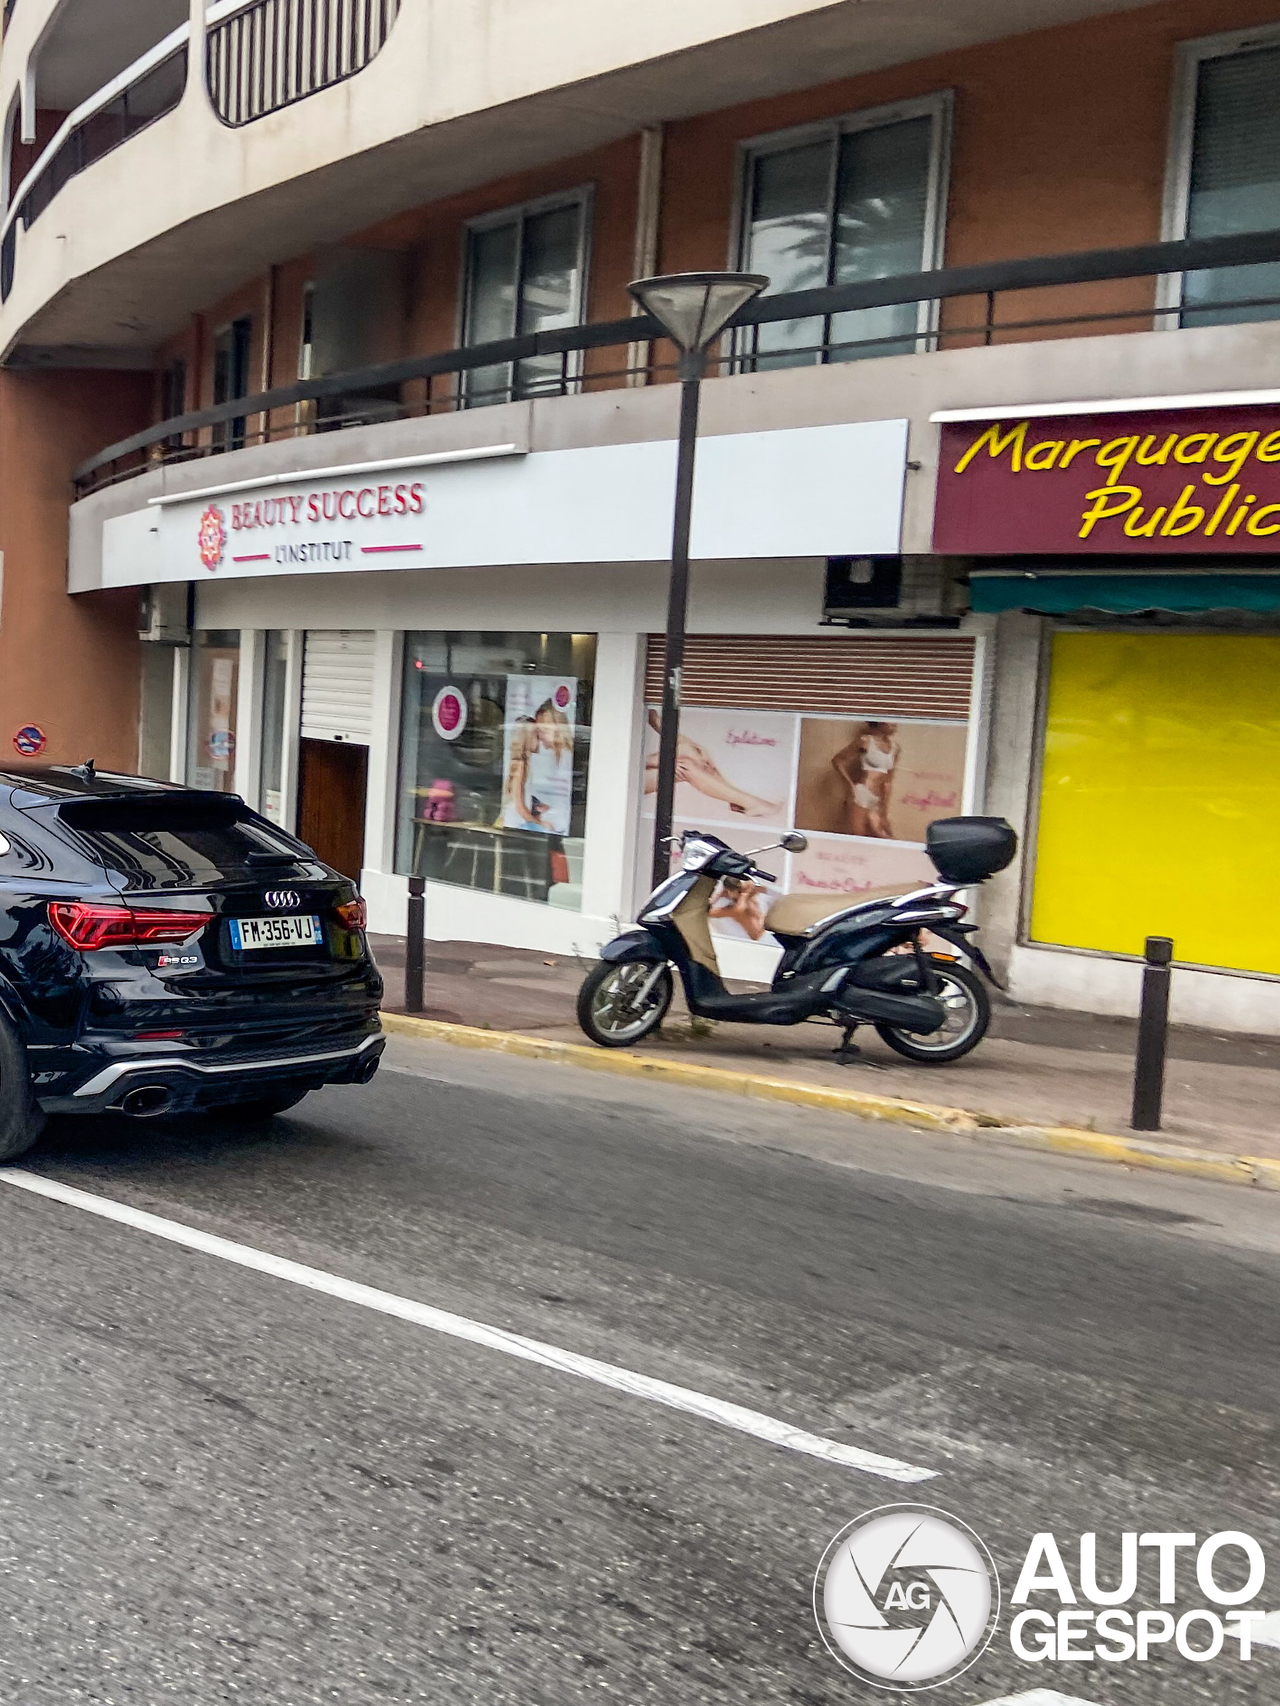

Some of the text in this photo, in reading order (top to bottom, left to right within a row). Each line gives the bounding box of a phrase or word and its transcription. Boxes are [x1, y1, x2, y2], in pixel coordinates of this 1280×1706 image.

[954, 420, 1280, 486] Marquage
[231, 482, 426, 532] BEAUTY SUCCESS
[1078, 483, 1280, 539] Public
[274, 539, 353, 564] L'INSTITUT
